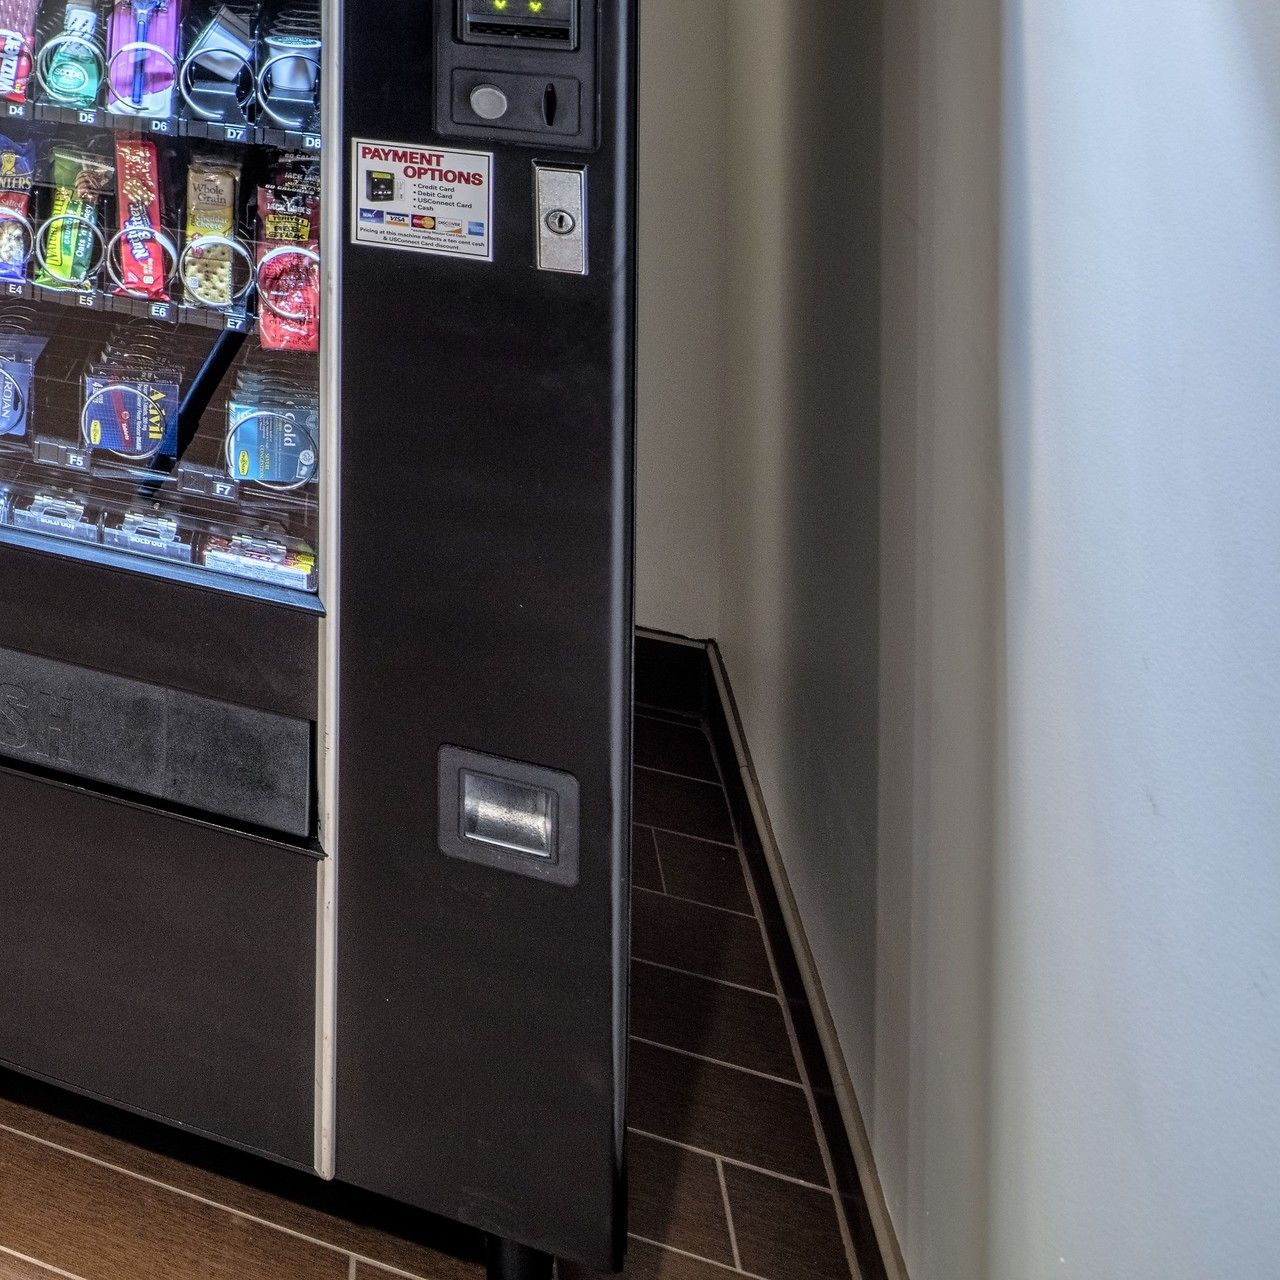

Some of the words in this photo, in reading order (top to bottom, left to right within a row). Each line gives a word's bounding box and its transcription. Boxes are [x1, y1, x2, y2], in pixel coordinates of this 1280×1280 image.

[9, 105, 23, 116] D4
[79, 112, 94, 123] D5
[152, 120, 167, 131] D6
[227, 128, 244, 139] D7
[362, 146, 444, 167] PAYMENT
[403, 165, 483, 186] OPTIONS
[192, 183, 224, 196] Whole
[418, 183, 438, 191] Credit
[197, 194, 227, 204] Grain
[418, 190, 436, 198] Debit
[437, 192, 452, 200] Card
[418, 198, 455, 208] USConnect
[456, 201, 472, 209] Card
[418, 204, 434, 212] Cash
[9, 284, 22, 294] E4
[79, 295, 93, 305] E5
[152, 306, 166, 317] E6
[227, 318, 241, 329] E7
[70, 455, 83, 466] F5
[216, 484, 232, 494] F7
